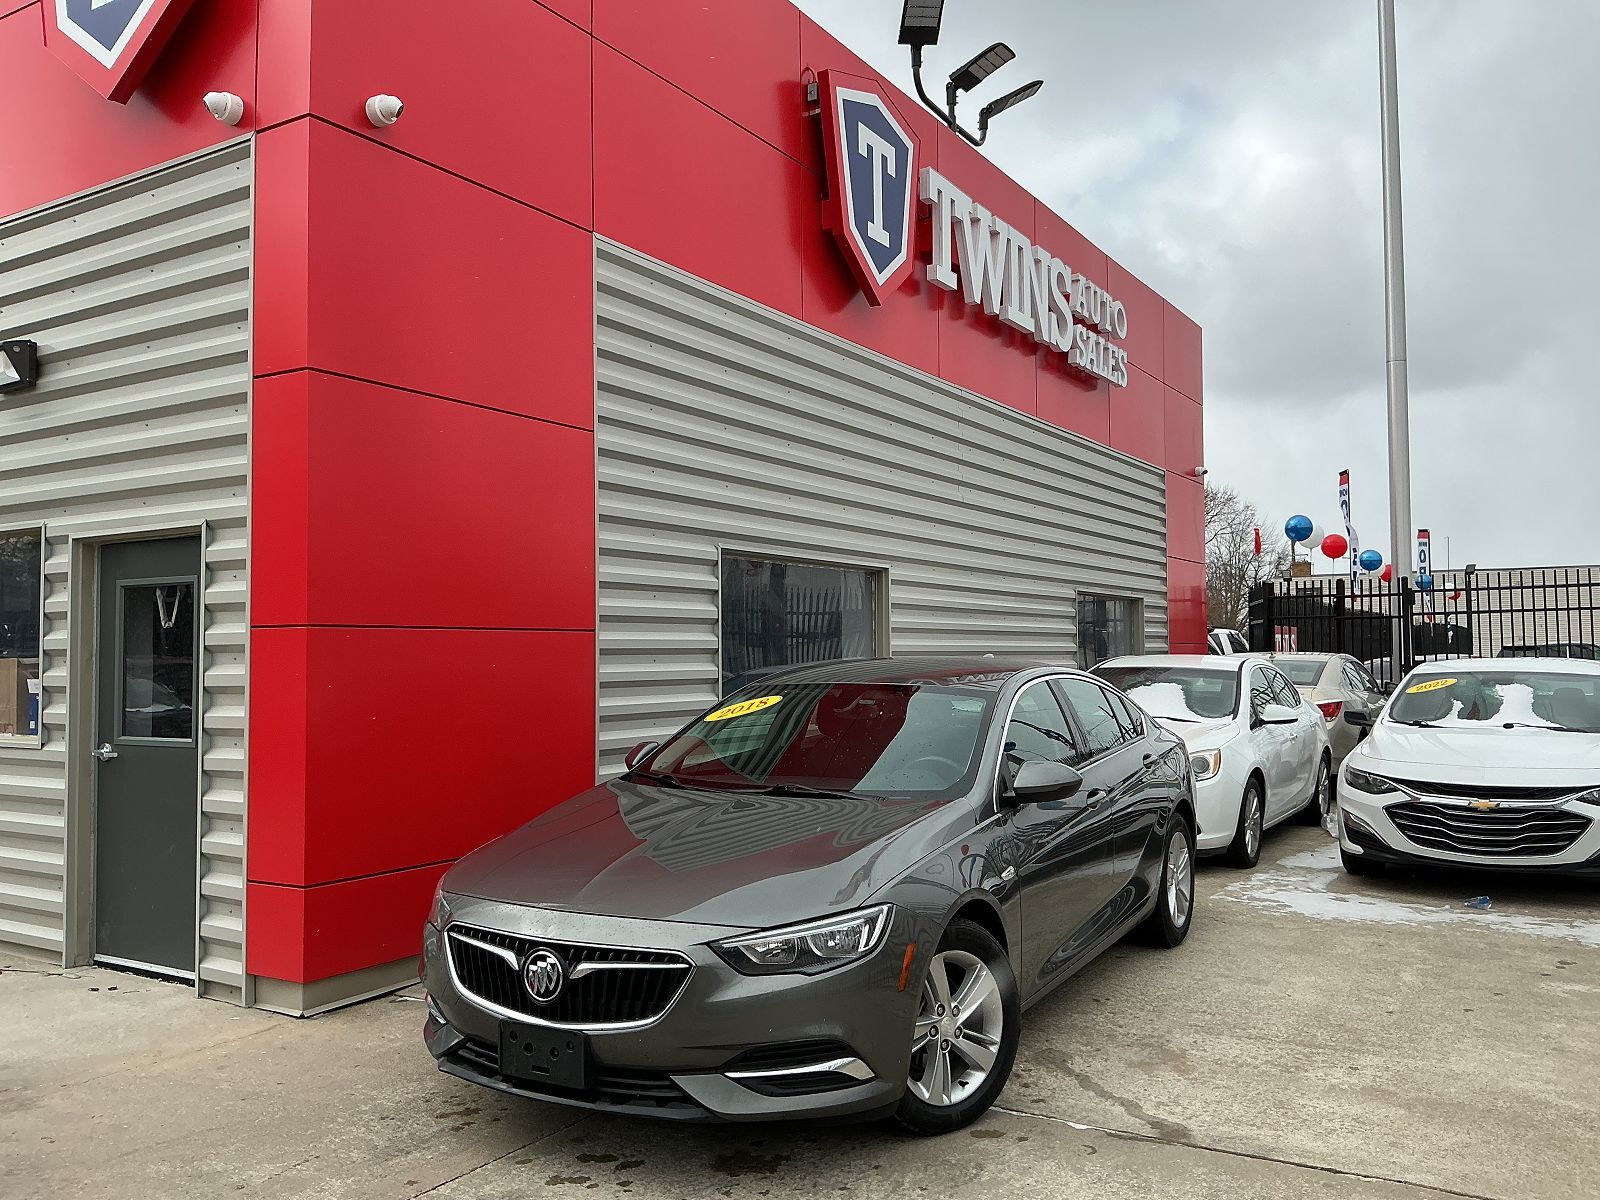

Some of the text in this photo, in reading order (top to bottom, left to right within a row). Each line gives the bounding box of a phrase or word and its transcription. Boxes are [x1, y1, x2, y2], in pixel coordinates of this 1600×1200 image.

[857, 121, 896, 248] T
[920, 166, 1073, 353] TWINS
[1072, 273, 1127, 339] AUTO
[1069, 324, 1127, 388] SALES
[716, 697, 770, 719] 2018
[1415, 679, 1448, 692] 2022
